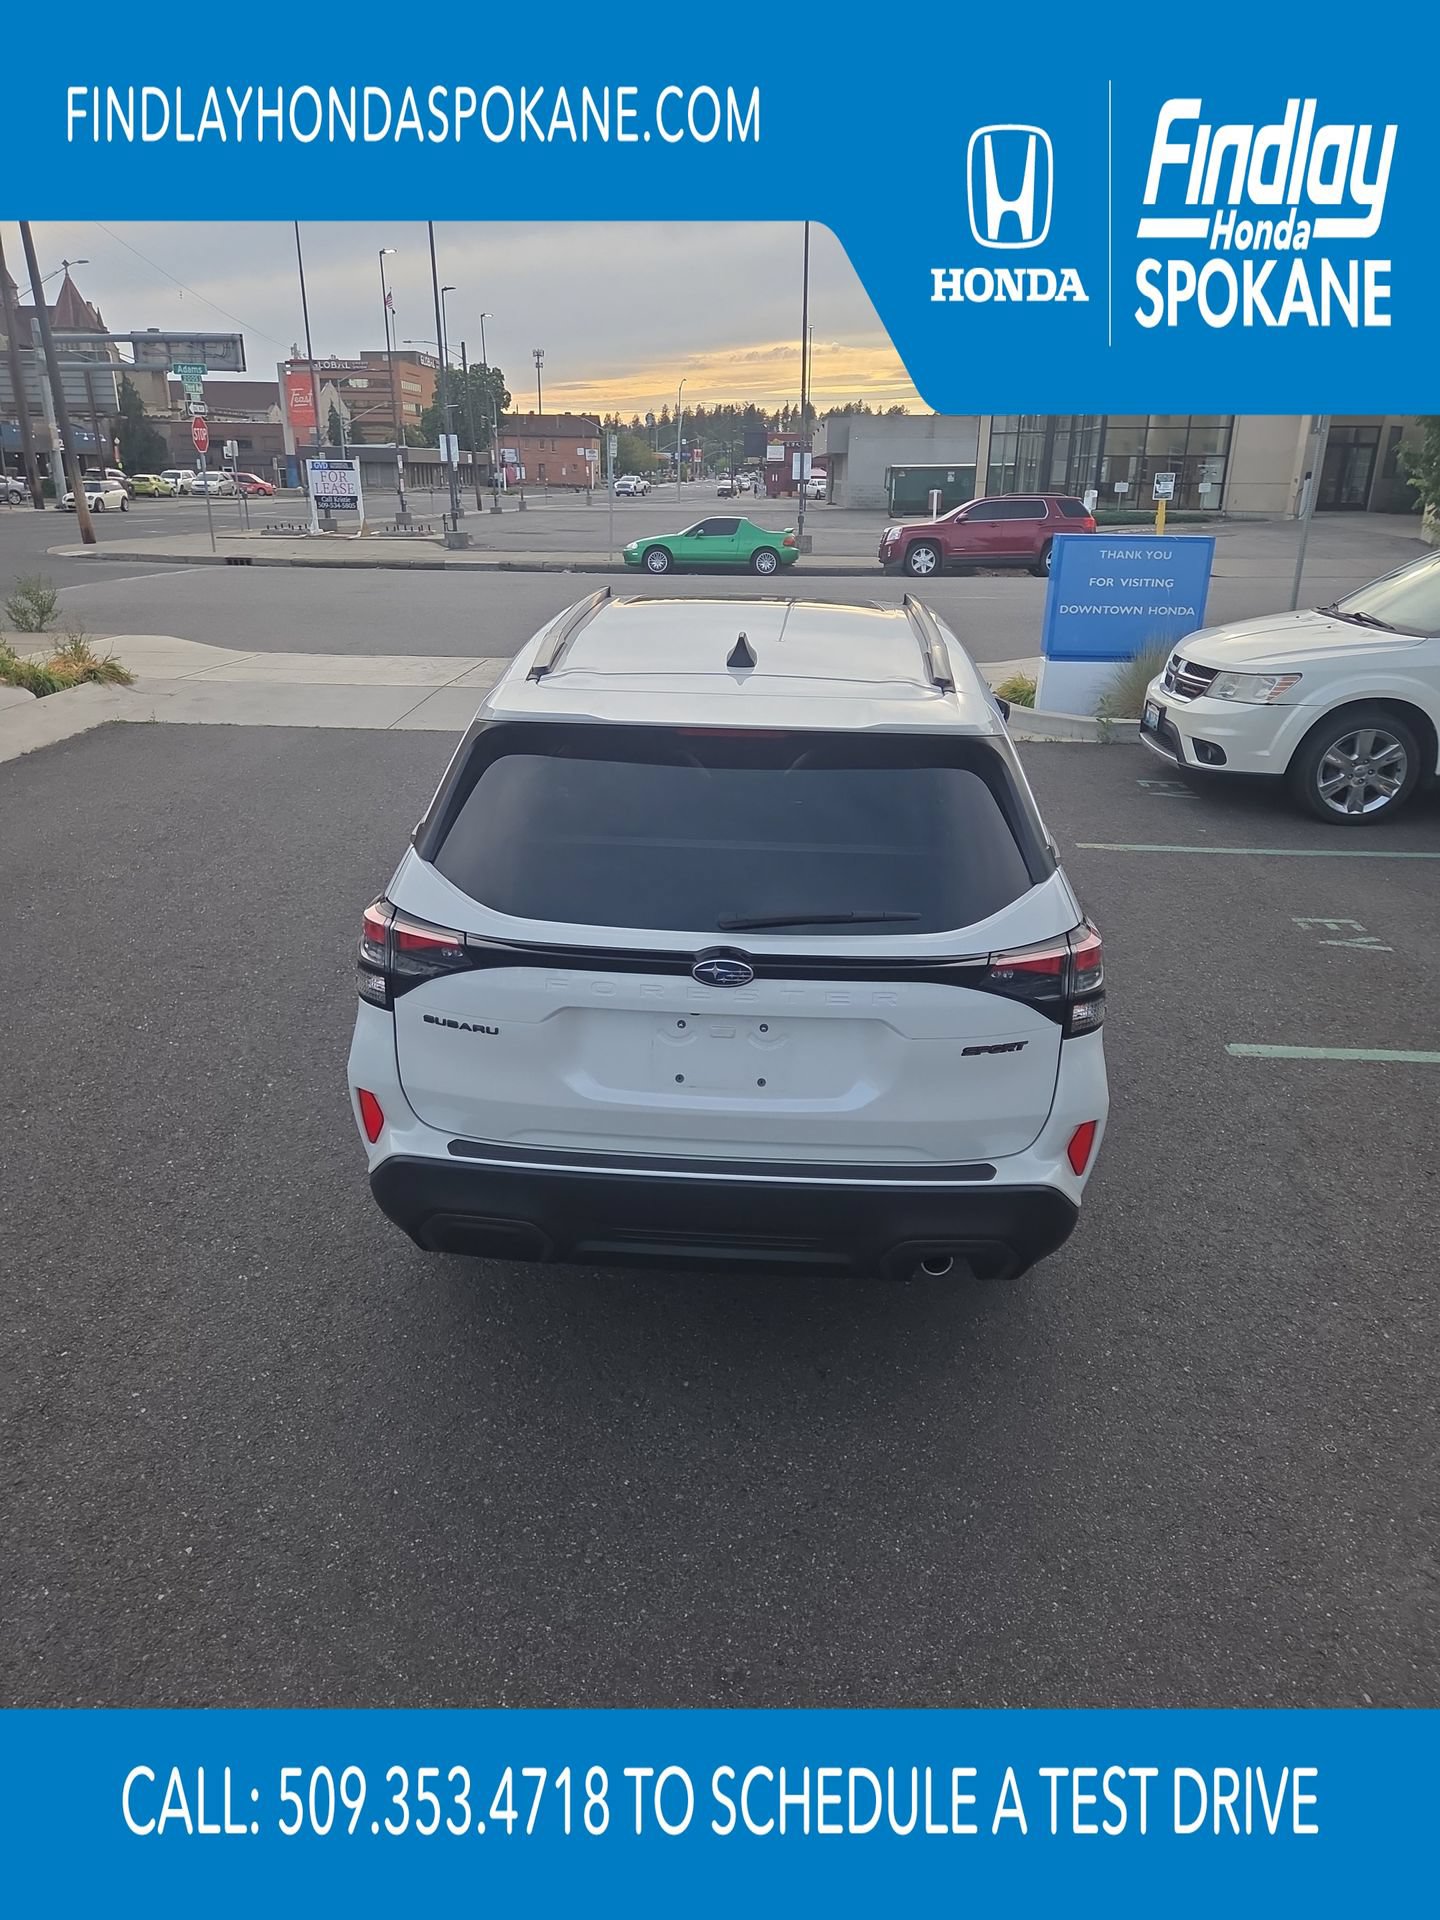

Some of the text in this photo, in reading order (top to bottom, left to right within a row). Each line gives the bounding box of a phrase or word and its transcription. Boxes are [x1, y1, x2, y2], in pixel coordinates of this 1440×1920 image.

[177, 365, 203, 374] Adams
[290, 388, 313, 408] Feast
[193, 428, 207, 440] STOP
[320, 471, 348, 482] FOR
[315, 483, 356, 494] LEASE
[1100, 550, 1173, 560] THANK YOU
[1089, 577, 1174, 588] FOR VISITING
[1059, 605, 1195, 616] DOWNTOWN HONDA
[544, 977, 898, 1008] FORESTER
[423, 1013, 500, 1036] SUBARU
[960, 1040, 1030, 1057] SPORT
